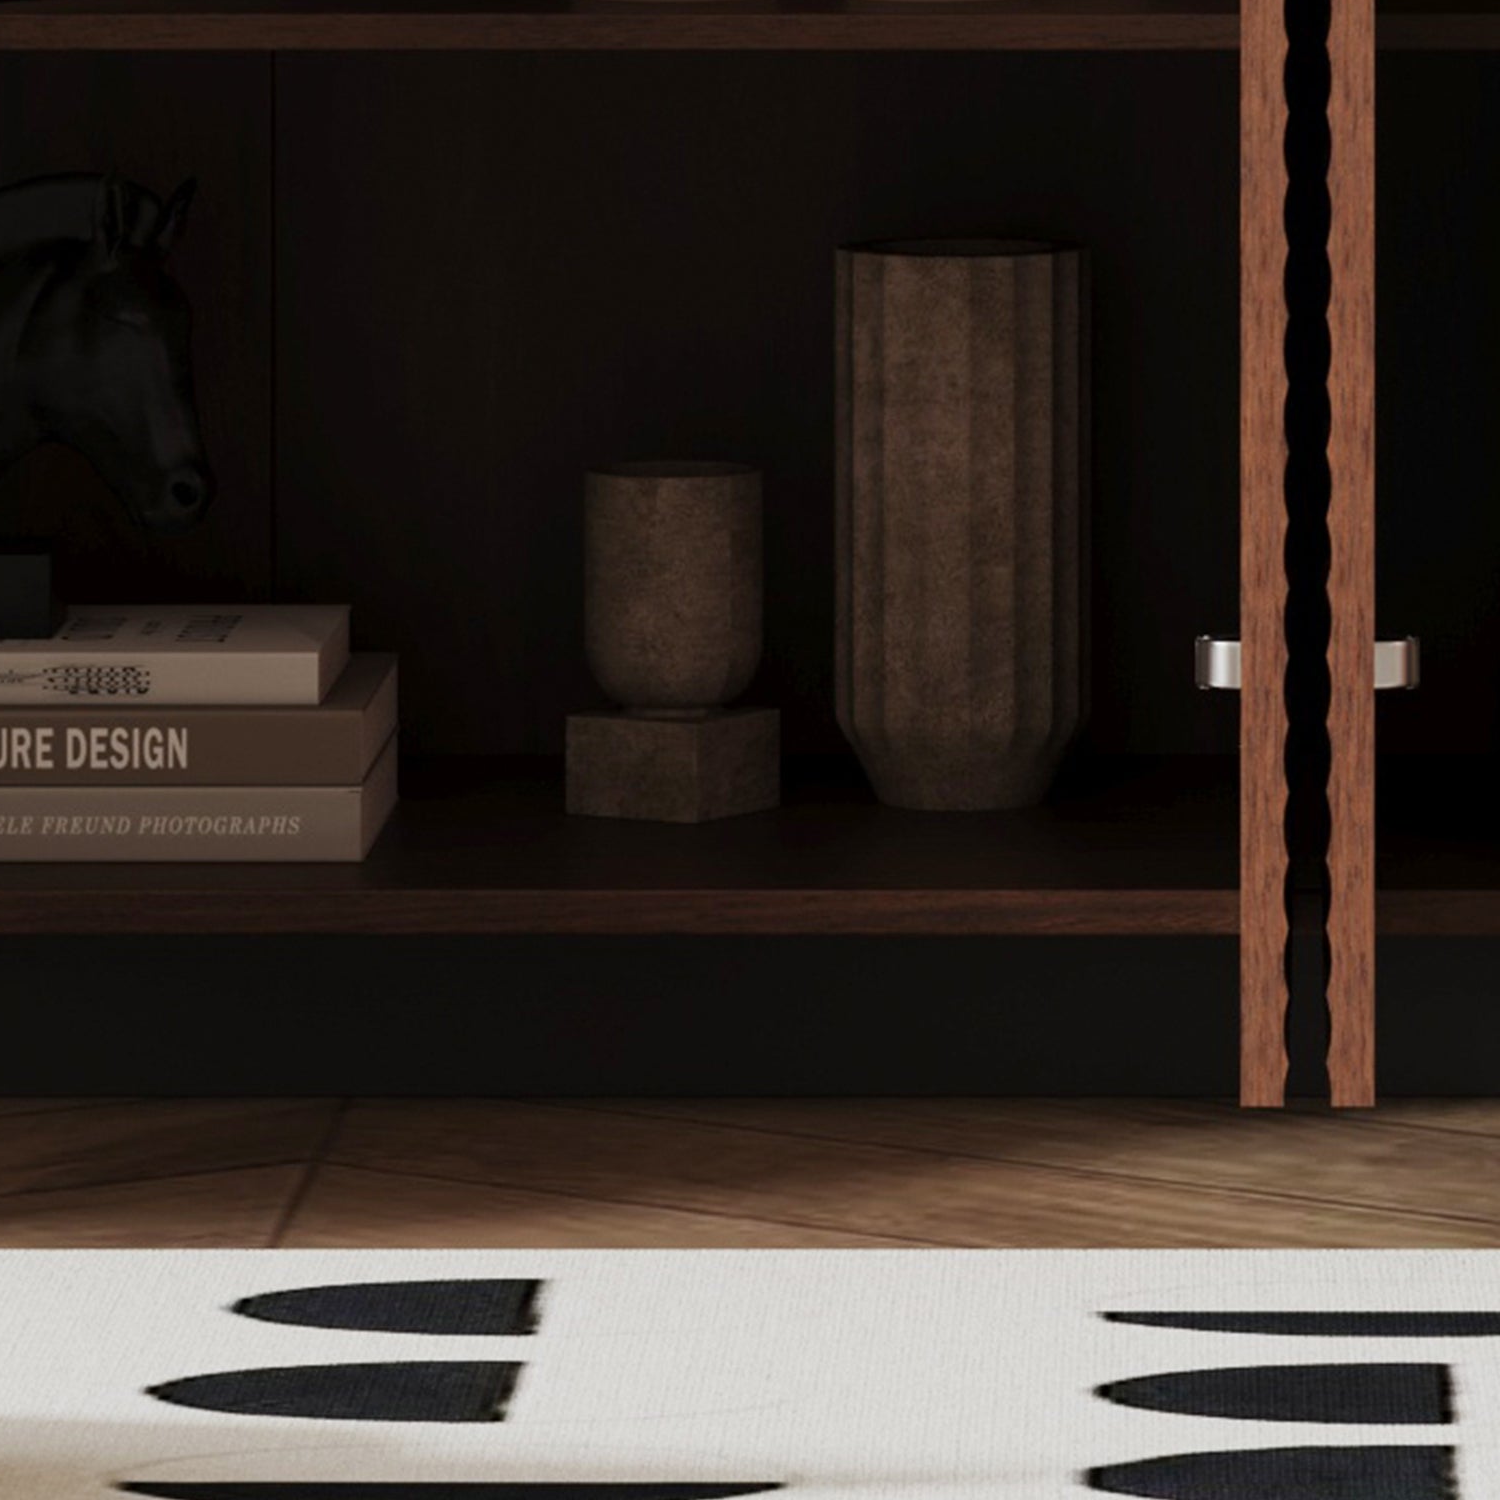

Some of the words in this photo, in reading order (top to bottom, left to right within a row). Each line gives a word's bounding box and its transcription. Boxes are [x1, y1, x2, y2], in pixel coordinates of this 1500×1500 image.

[66, 726, 188, 770] DESIGN
[41, 815, 132, 835] FREUND
[138, 815, 301, 835] PHOTOGRAPHS
